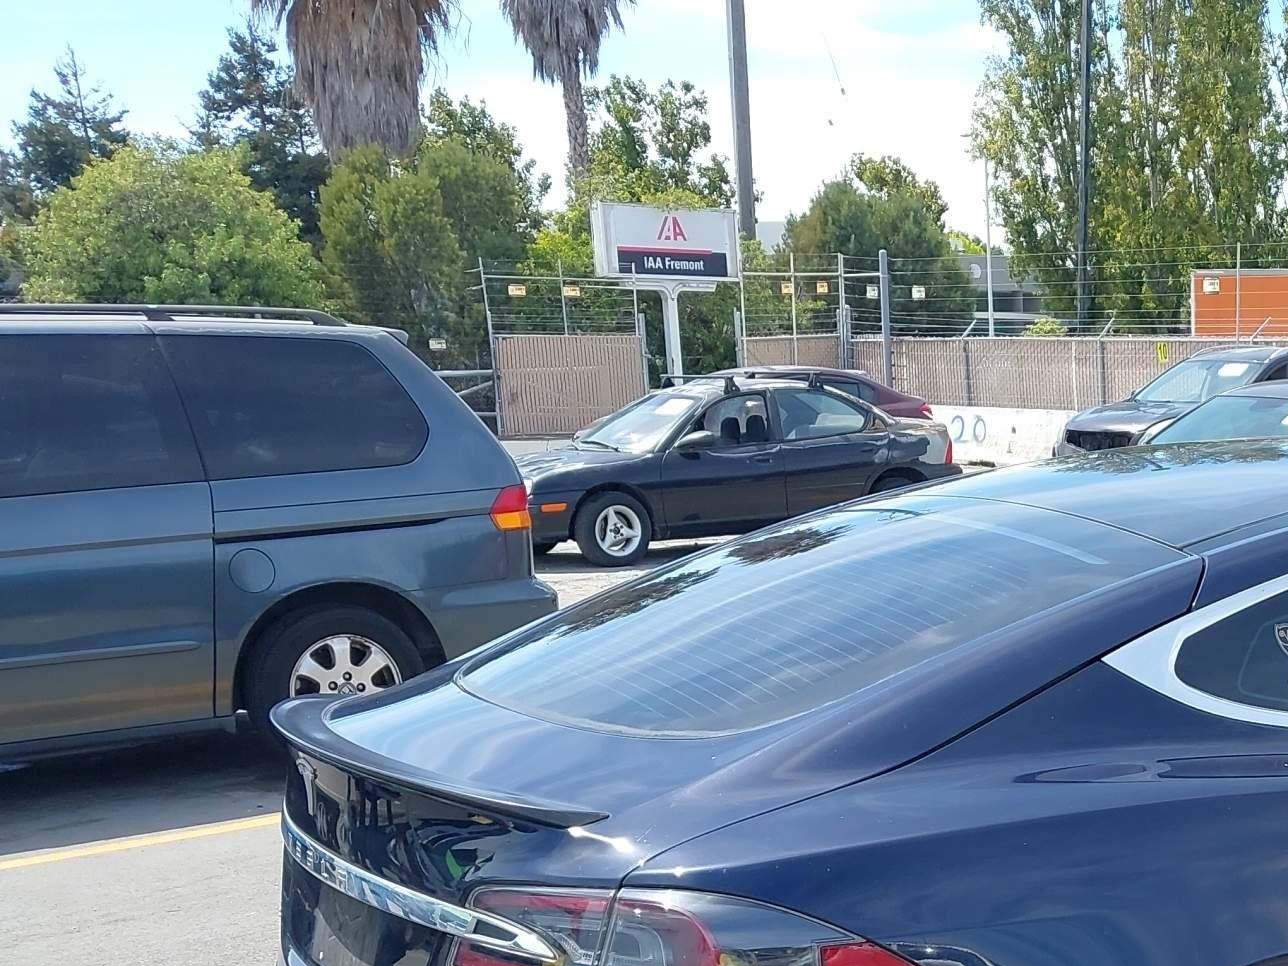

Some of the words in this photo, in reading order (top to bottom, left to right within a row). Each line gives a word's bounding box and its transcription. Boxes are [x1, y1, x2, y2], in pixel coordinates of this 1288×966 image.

[644, 256, 664, 269] IAA
[665, 257, 705, 270] Fremont
[1158, 343, 1168, 360] 10
